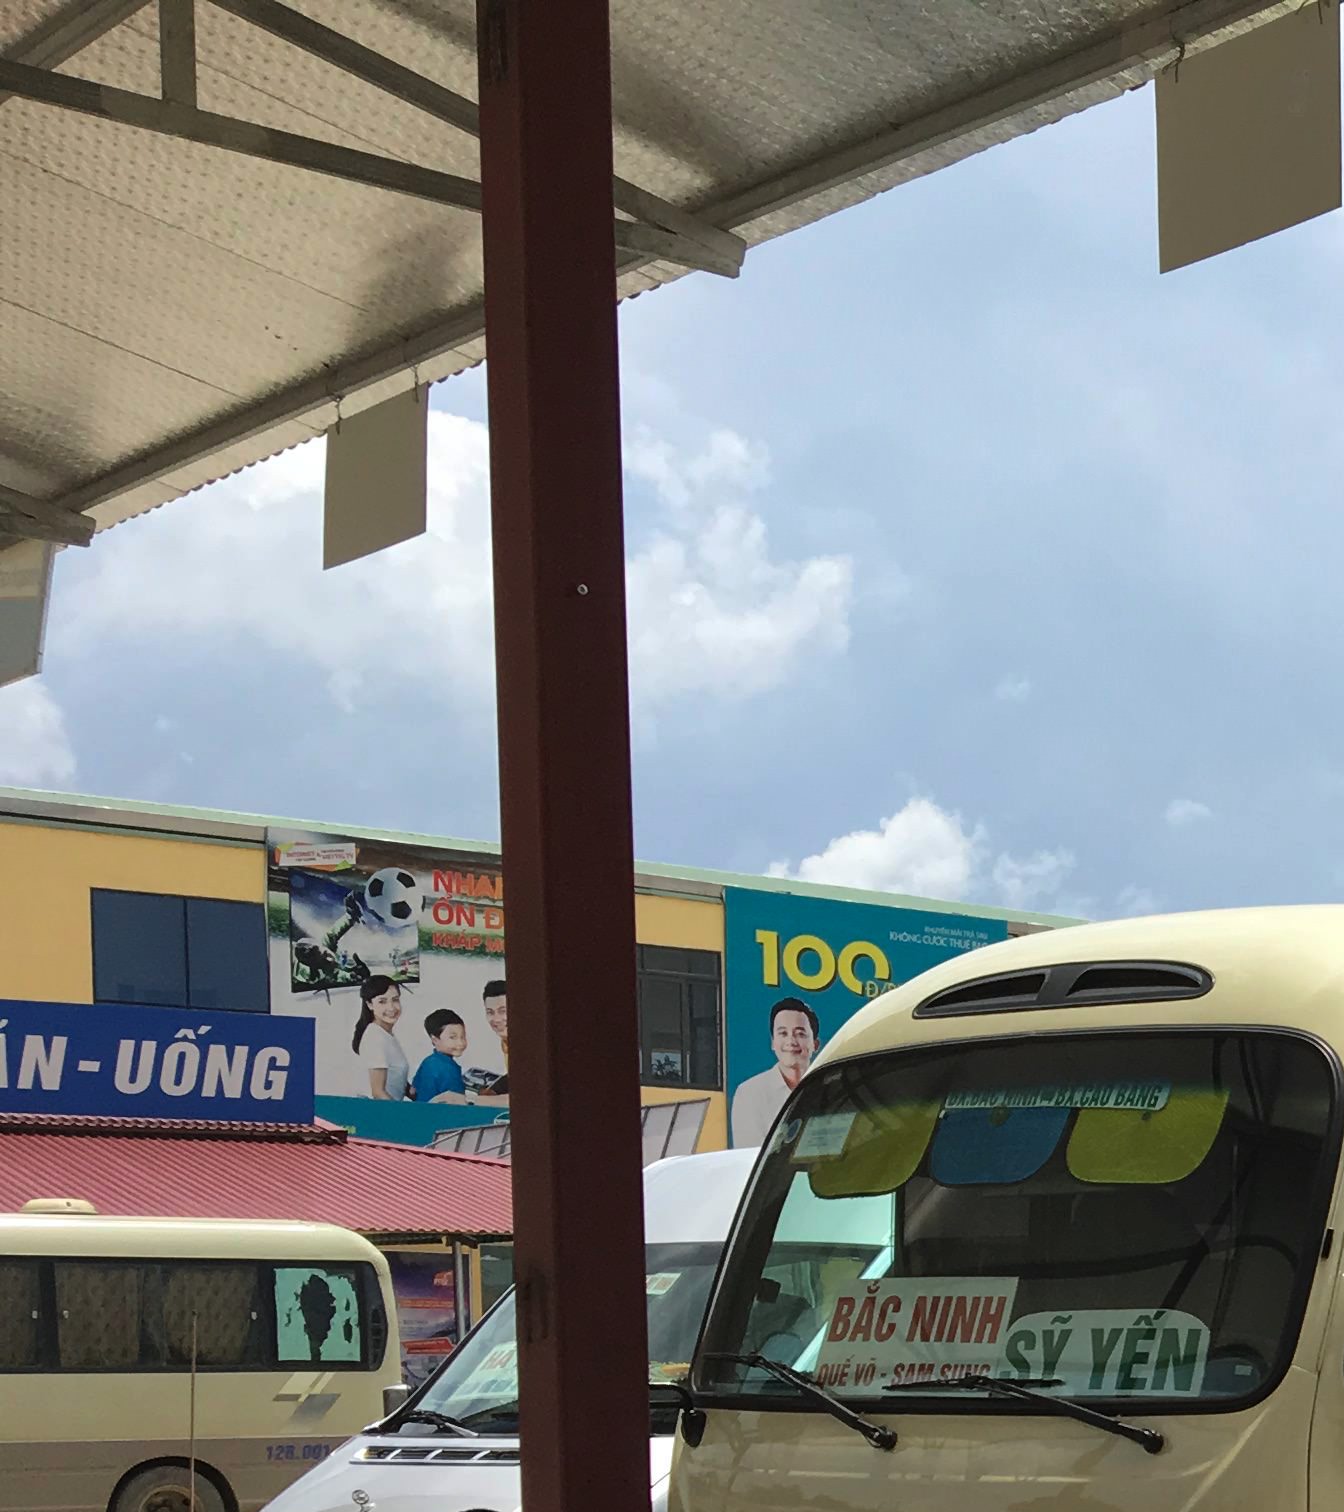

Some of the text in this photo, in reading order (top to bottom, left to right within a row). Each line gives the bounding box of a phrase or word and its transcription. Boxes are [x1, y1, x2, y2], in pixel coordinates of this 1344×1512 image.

[756, 928, 891, 996] 100
[114, 1025, 291, 1102] UỐNG
[826, 1282, 1007, 1344] BẮC NINH
[816, 1355, 851, 1387] QUẾ
[892, 1360, 934, 1386] SAM
[1005, 1310, 1202, 1392] SỸ YẾN
